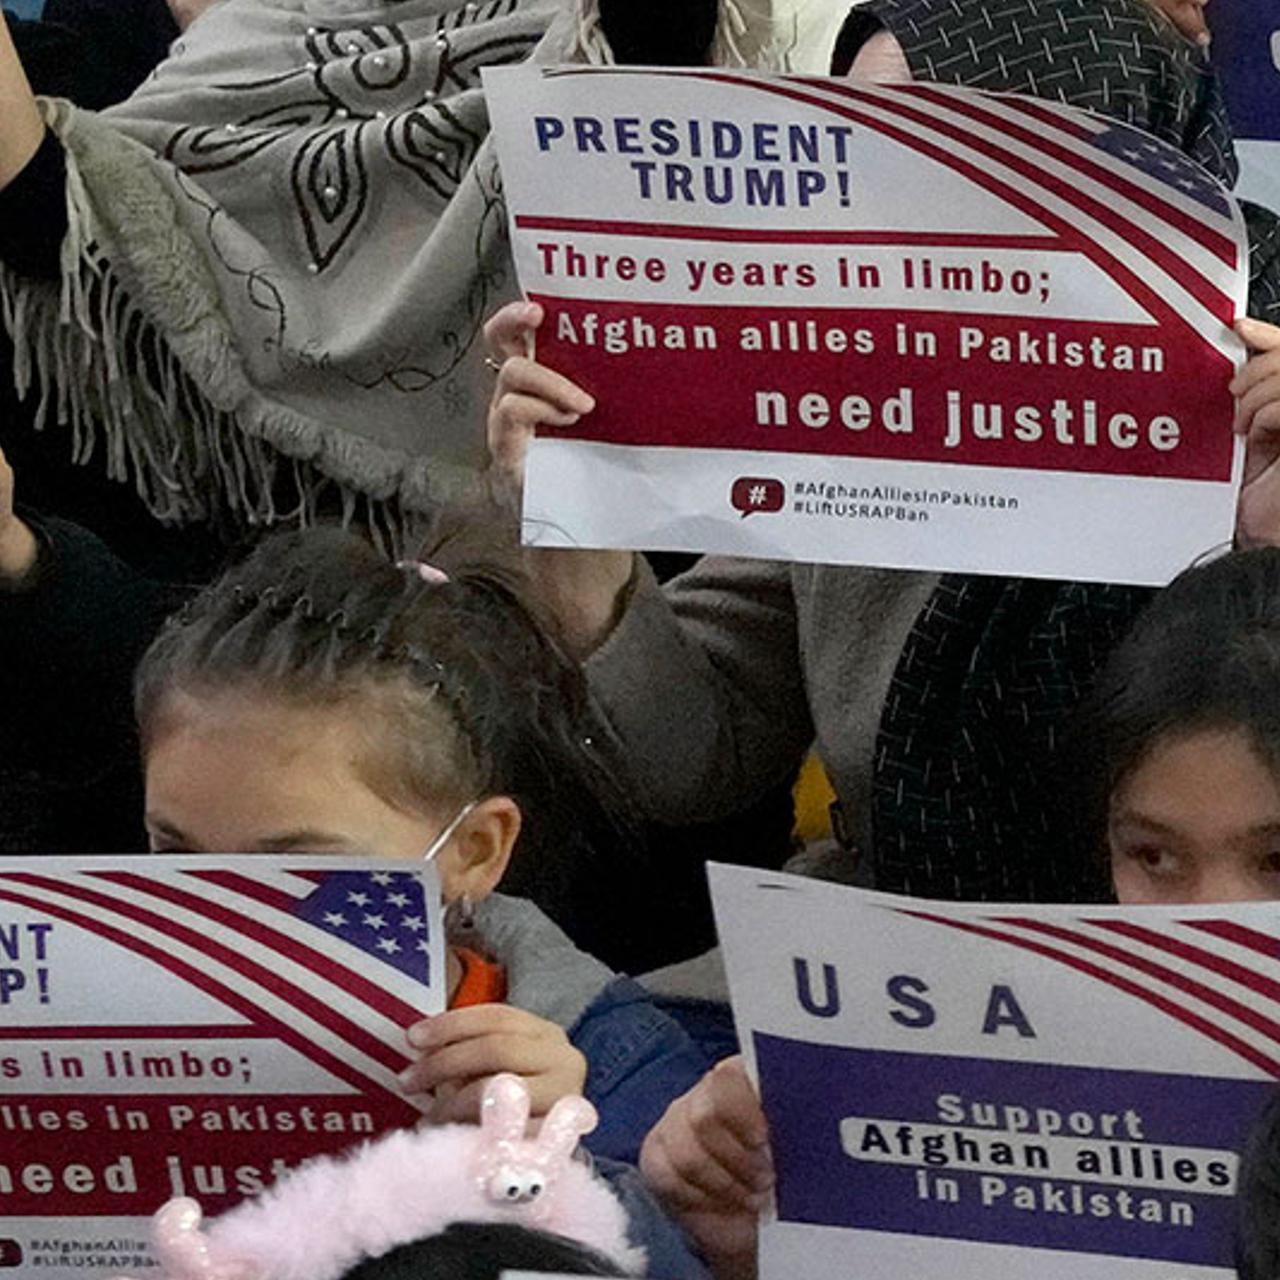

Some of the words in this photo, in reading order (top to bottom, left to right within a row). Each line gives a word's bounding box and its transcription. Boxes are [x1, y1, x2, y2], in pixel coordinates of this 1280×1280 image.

[535, 117, 852, 163] PRESIDENT
[631, 161, 850, 207] TRUMP!
[537, 243, 665, 282] Three
[687, 261, 816, 291] years
[559, 313, 716, 353] Afghan
[741, 321, 874, 353] allies
[960, 328, 1162, 371] Pakistan
[756, 388, 912, 432] need
[945, 391, 1179, 450] justice
[172, 1106, 374, 1132] Pakistan
[937, 1095, 1143, 1139] Support
[861, 1124, 1048, 1168] Afghan
[1077, 1146, 1229, 1186] allies
[981, 1177, 1192, 1225] Pakistan
